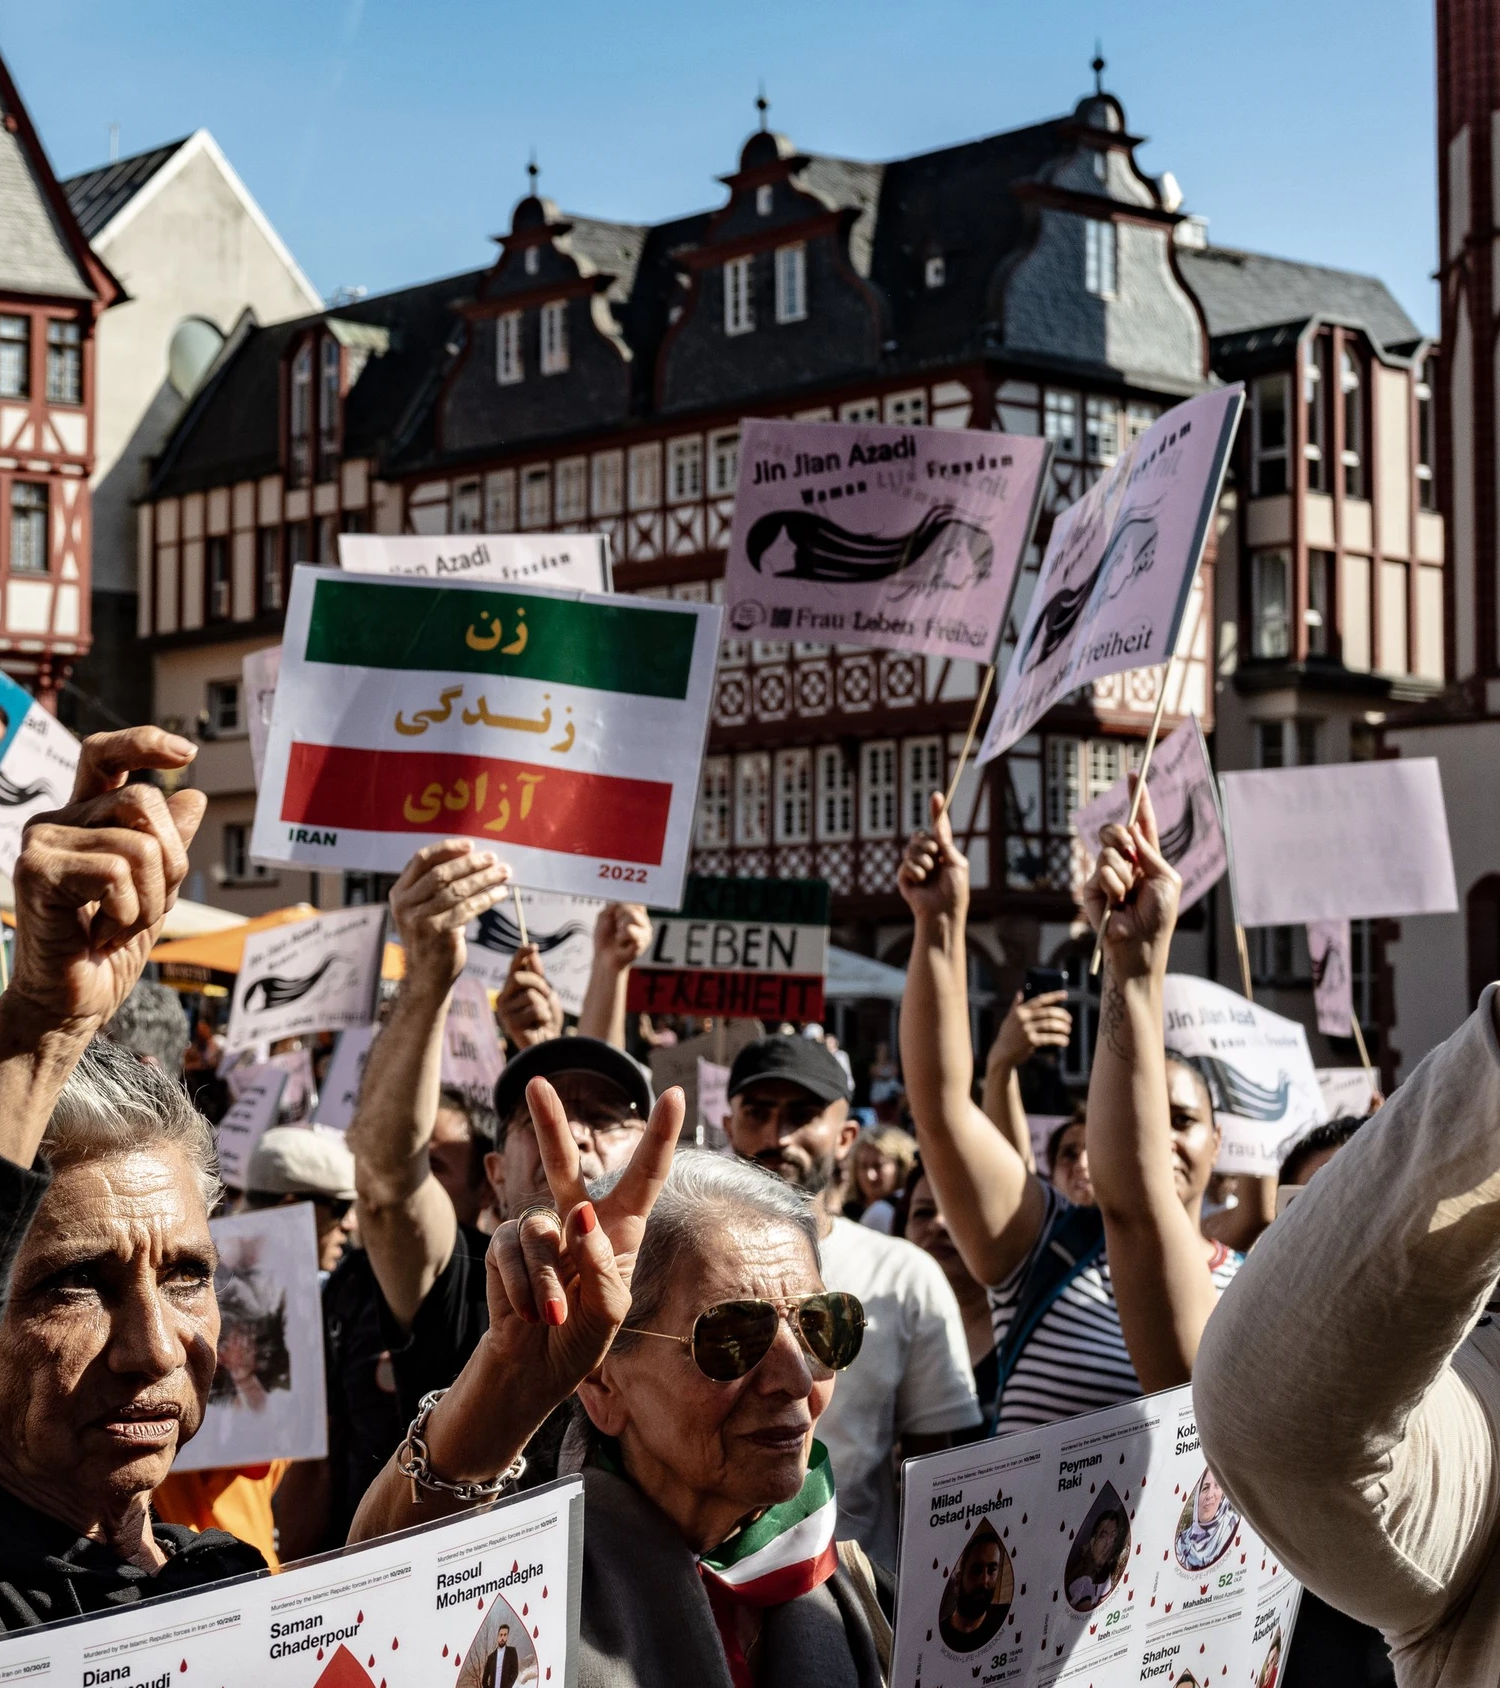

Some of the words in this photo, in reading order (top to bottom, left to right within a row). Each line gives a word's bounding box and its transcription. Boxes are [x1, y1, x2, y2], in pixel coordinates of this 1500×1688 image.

[753, 461, 786, 486] Jin
[793, 451, 842, 478] Jian
[848, 435, 917, 468] Azadi
[435, 543, 492, 576] Azadi
[464, 606, 529, 656] زن
[797, 607, 845, 630] Frau
[853, 611, 914, 637] Leben
[403, 772, 545, 832] آزادی
[288, 828, 338, 848] IRAN
[598, 863, 648, 884] 2022
[652, 922, 798, 969] LEBEN
[639, 969, 820, 1017] FREIHEIT
[1167, 1011, 1194, 1031] Jin
[1059, 1454, 1103, 1475] Peyman
[1058, 1473, 1083, 1493] Raki
[930, 1506, 965, 1528] Ostad
[966, 1496, 1013, 1518] Hashem
[931, 1490, 963, 1511] Milad
[437, 1552, 459, 1563] Murdered
[473, 1542, 489, 1552] Islamic
[489, 1536, 507, 1546] Republic
[508, 1532, 521, 1540] forces
[436, 1563, 544, 1610] Mohammadagha
[437, 1561, 482, 1591] Rasoul
[1218, 1572, 1234, 1588] 52
[271, 1600, 295, 1612] Murdered
[313, 1591, 330, 1601] Islamic
[330, 1584, 351, 1596] Republic
[352, 1581, 367, 1589] forces
[373, 1575, 383, 1583] Iran
[1183, 1594, 1213, 1610] Mahabad
[271, 1614, 324, 1639] Saman
[1106, 1610, 1121, 1627] 29
[83, 1648, 111, 1659] Murdered
[119, 1643, 129, 1651] the
[129, 1638, 148, 1649] Islamic
[149, 1632, 173, 1644] Republic
[173, 1628, 191, 1637] forces
[197, 1623, 208, 1631] Iran
[270, 1623, 360, 1660] Ghaderpour
[991, 1652, 1007, 1670] 38
[1142, 1645, 1181, 1666] Shahou
[1, 1670, 13, 1678] Iran
[83, 1666, 131, 1688] Diana
[1140, 1659, 1173, 1681] Khezri
